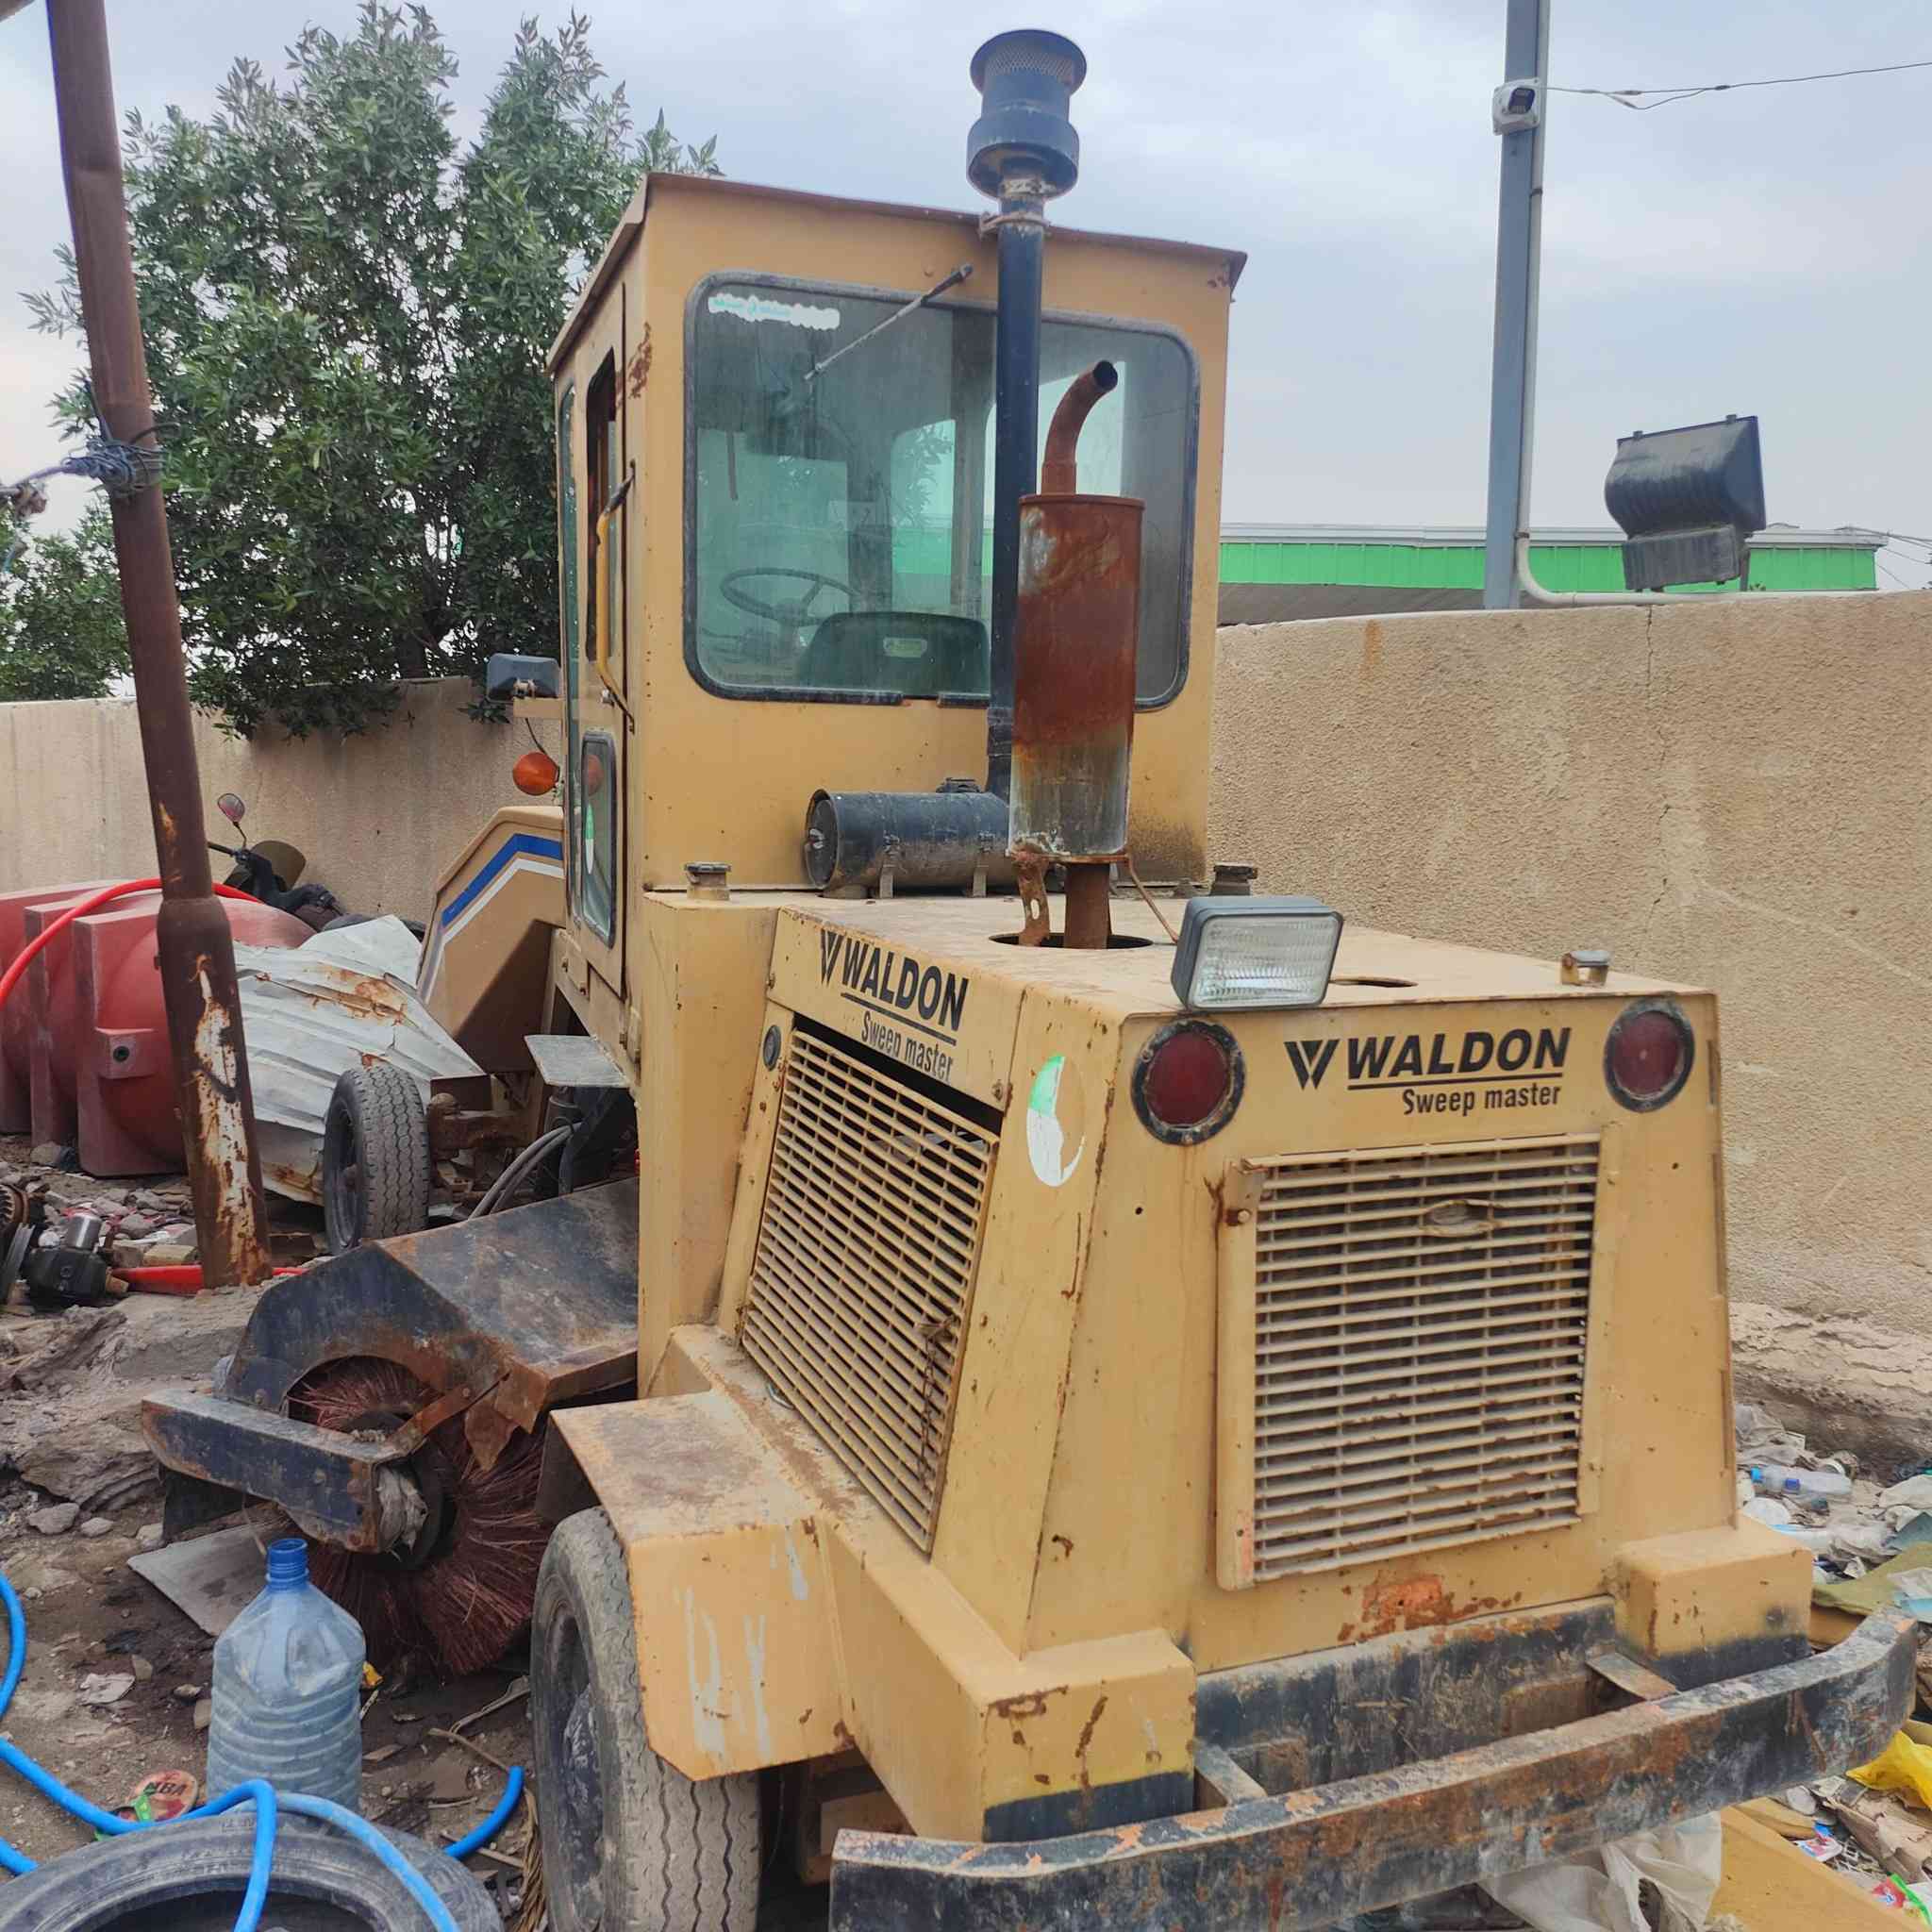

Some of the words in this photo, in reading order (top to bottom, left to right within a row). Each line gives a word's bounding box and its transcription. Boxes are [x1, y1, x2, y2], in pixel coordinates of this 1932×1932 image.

[841, 938, 970, 1032] WALDON
[904, 1039, 954, 1084] master
[1347, 1027, 1573, 1080] WALDON
[1402, 1088, 1476, 1117] Sweep
[1484, 1083, 1561, 1108] master
